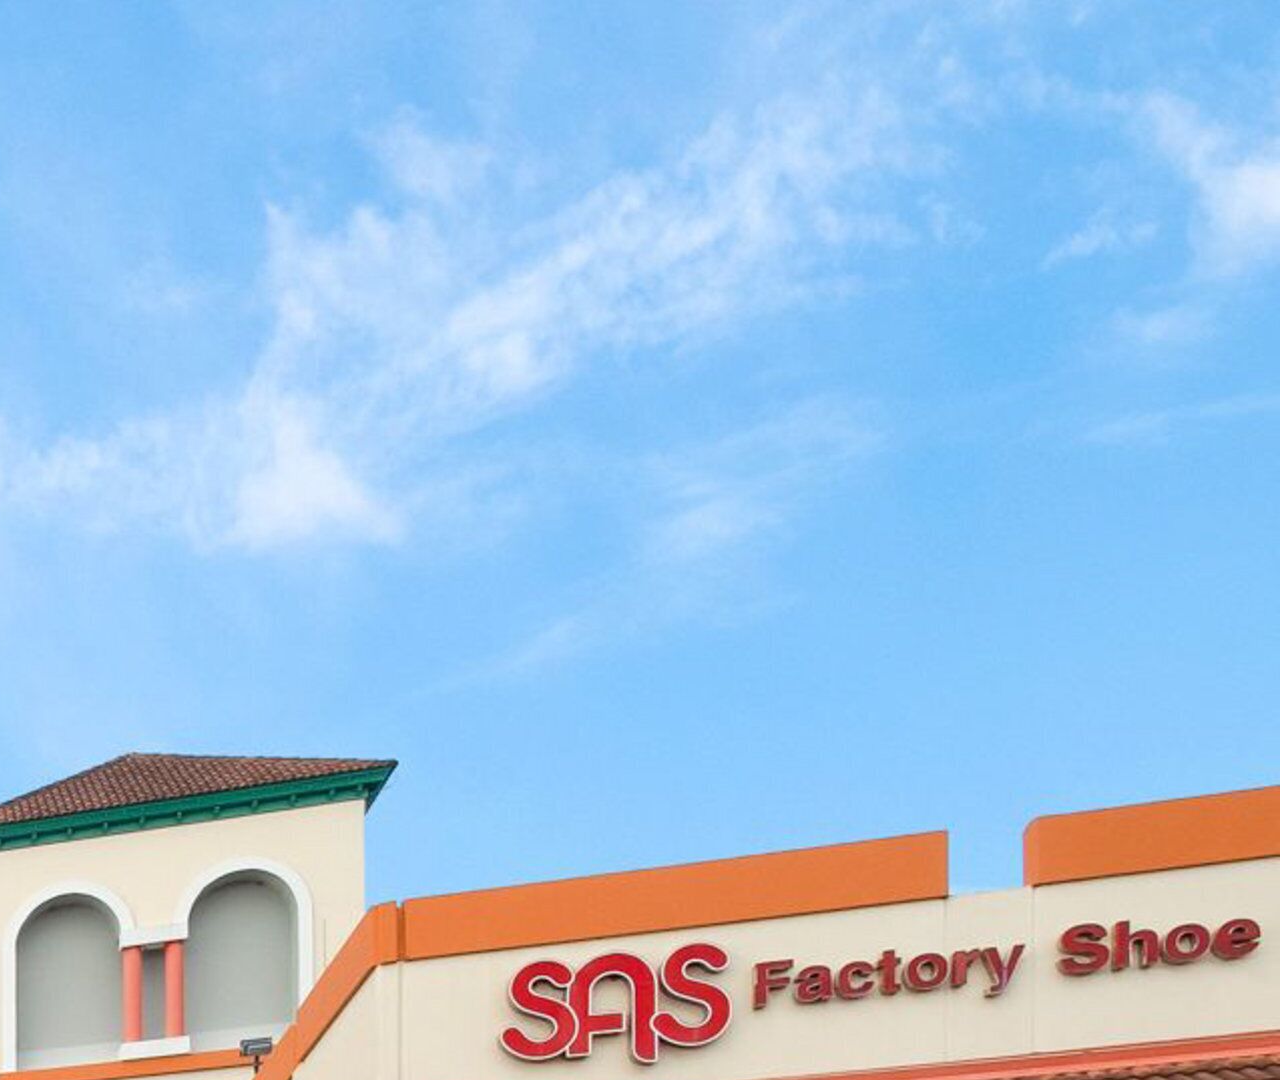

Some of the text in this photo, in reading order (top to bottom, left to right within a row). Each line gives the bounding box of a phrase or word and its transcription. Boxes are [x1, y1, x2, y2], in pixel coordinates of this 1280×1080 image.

[498, 917, 1262, 1066] SAS Factory Shoe
